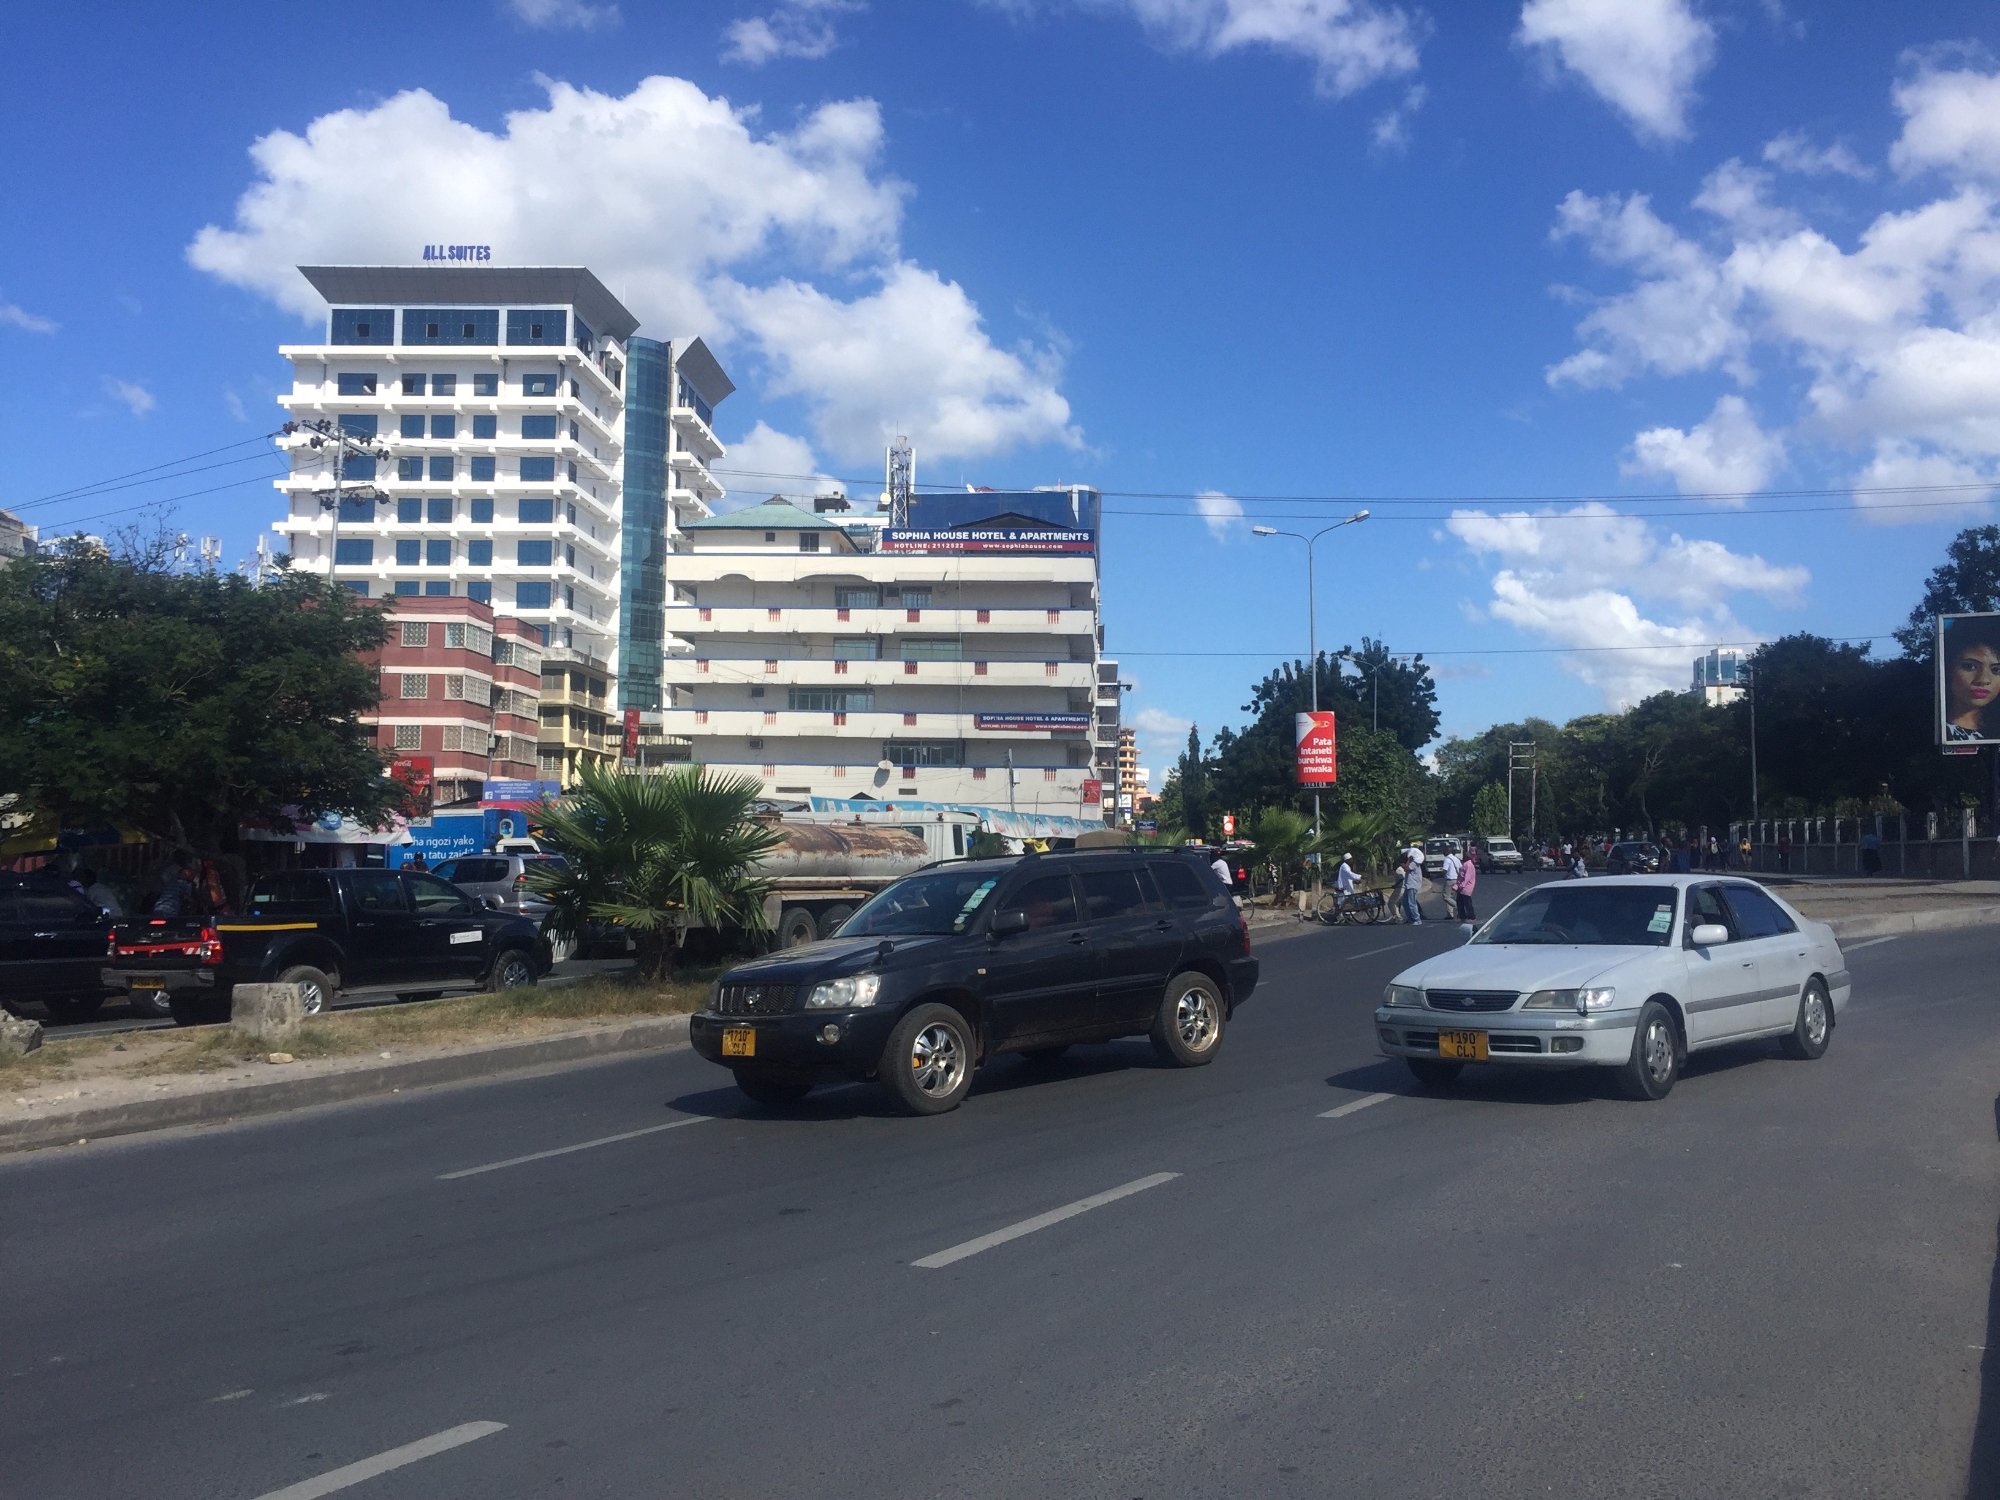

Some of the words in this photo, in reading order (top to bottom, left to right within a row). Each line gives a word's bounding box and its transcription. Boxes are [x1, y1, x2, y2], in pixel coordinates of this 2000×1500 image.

[448, 245, 490, 261] SUITES
[892, 532, 930, 540] SOPHIA
[934, 532, 969, 540] HOUSE
[972, 532, 1005, 540] HOTEL
[1009, 532, 1016, 540] &
[1020, 532, 1089, 541] APARTMENTS
[1298, 756, 1314, 764] bure
[1315, 756, 1332, 764] kwa
[1303, 765, 1332, 773] mwaka
[426, 836, 451, 848] ngozi
[453, 834, 474, 848] yako
[428, 851, 446, 859] tatu
[1448, 1032, 1475, 1044] T190
[1456, 1045, 1476, 1058] CLJ
